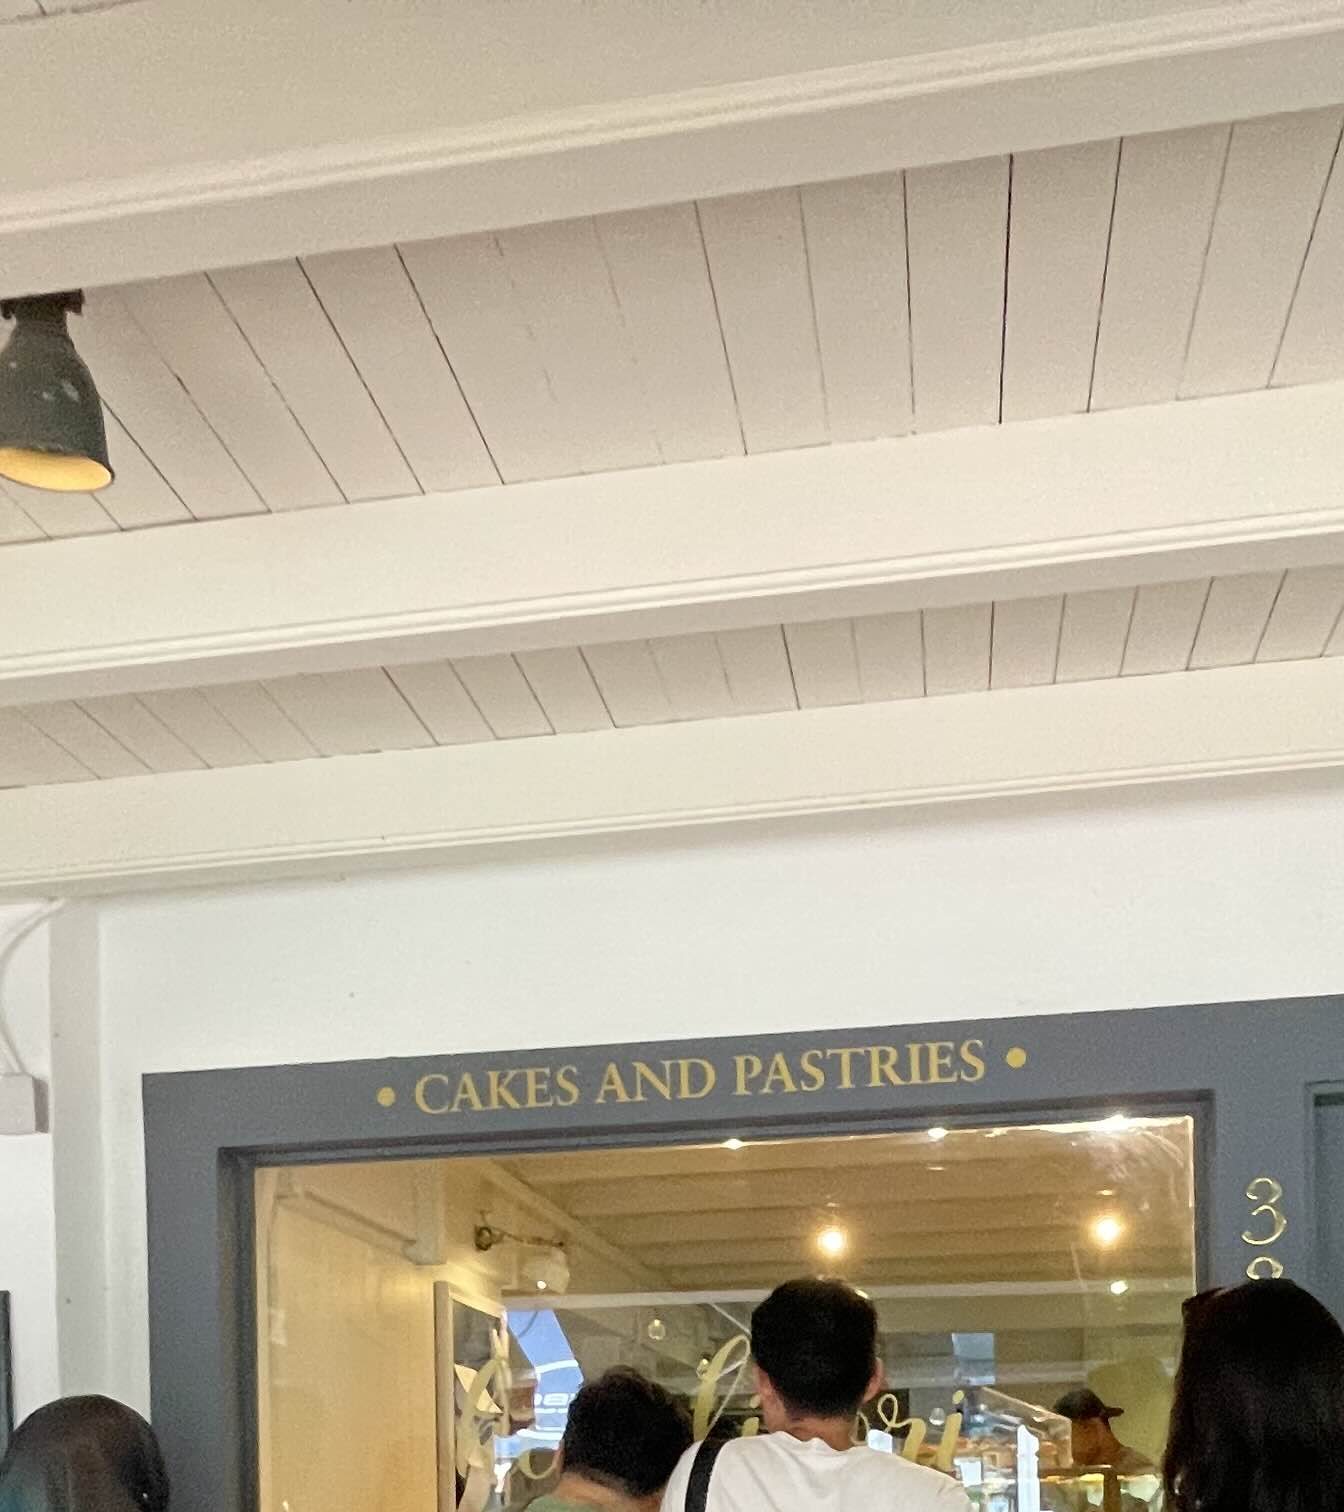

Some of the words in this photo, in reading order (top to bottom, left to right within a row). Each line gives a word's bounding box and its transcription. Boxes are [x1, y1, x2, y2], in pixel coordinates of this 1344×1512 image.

[414, 1065, 580, 1115] CAKES
[596, 1056, 716, 1106] AND
[732, 1038, 987, 1097] PASTRIES
